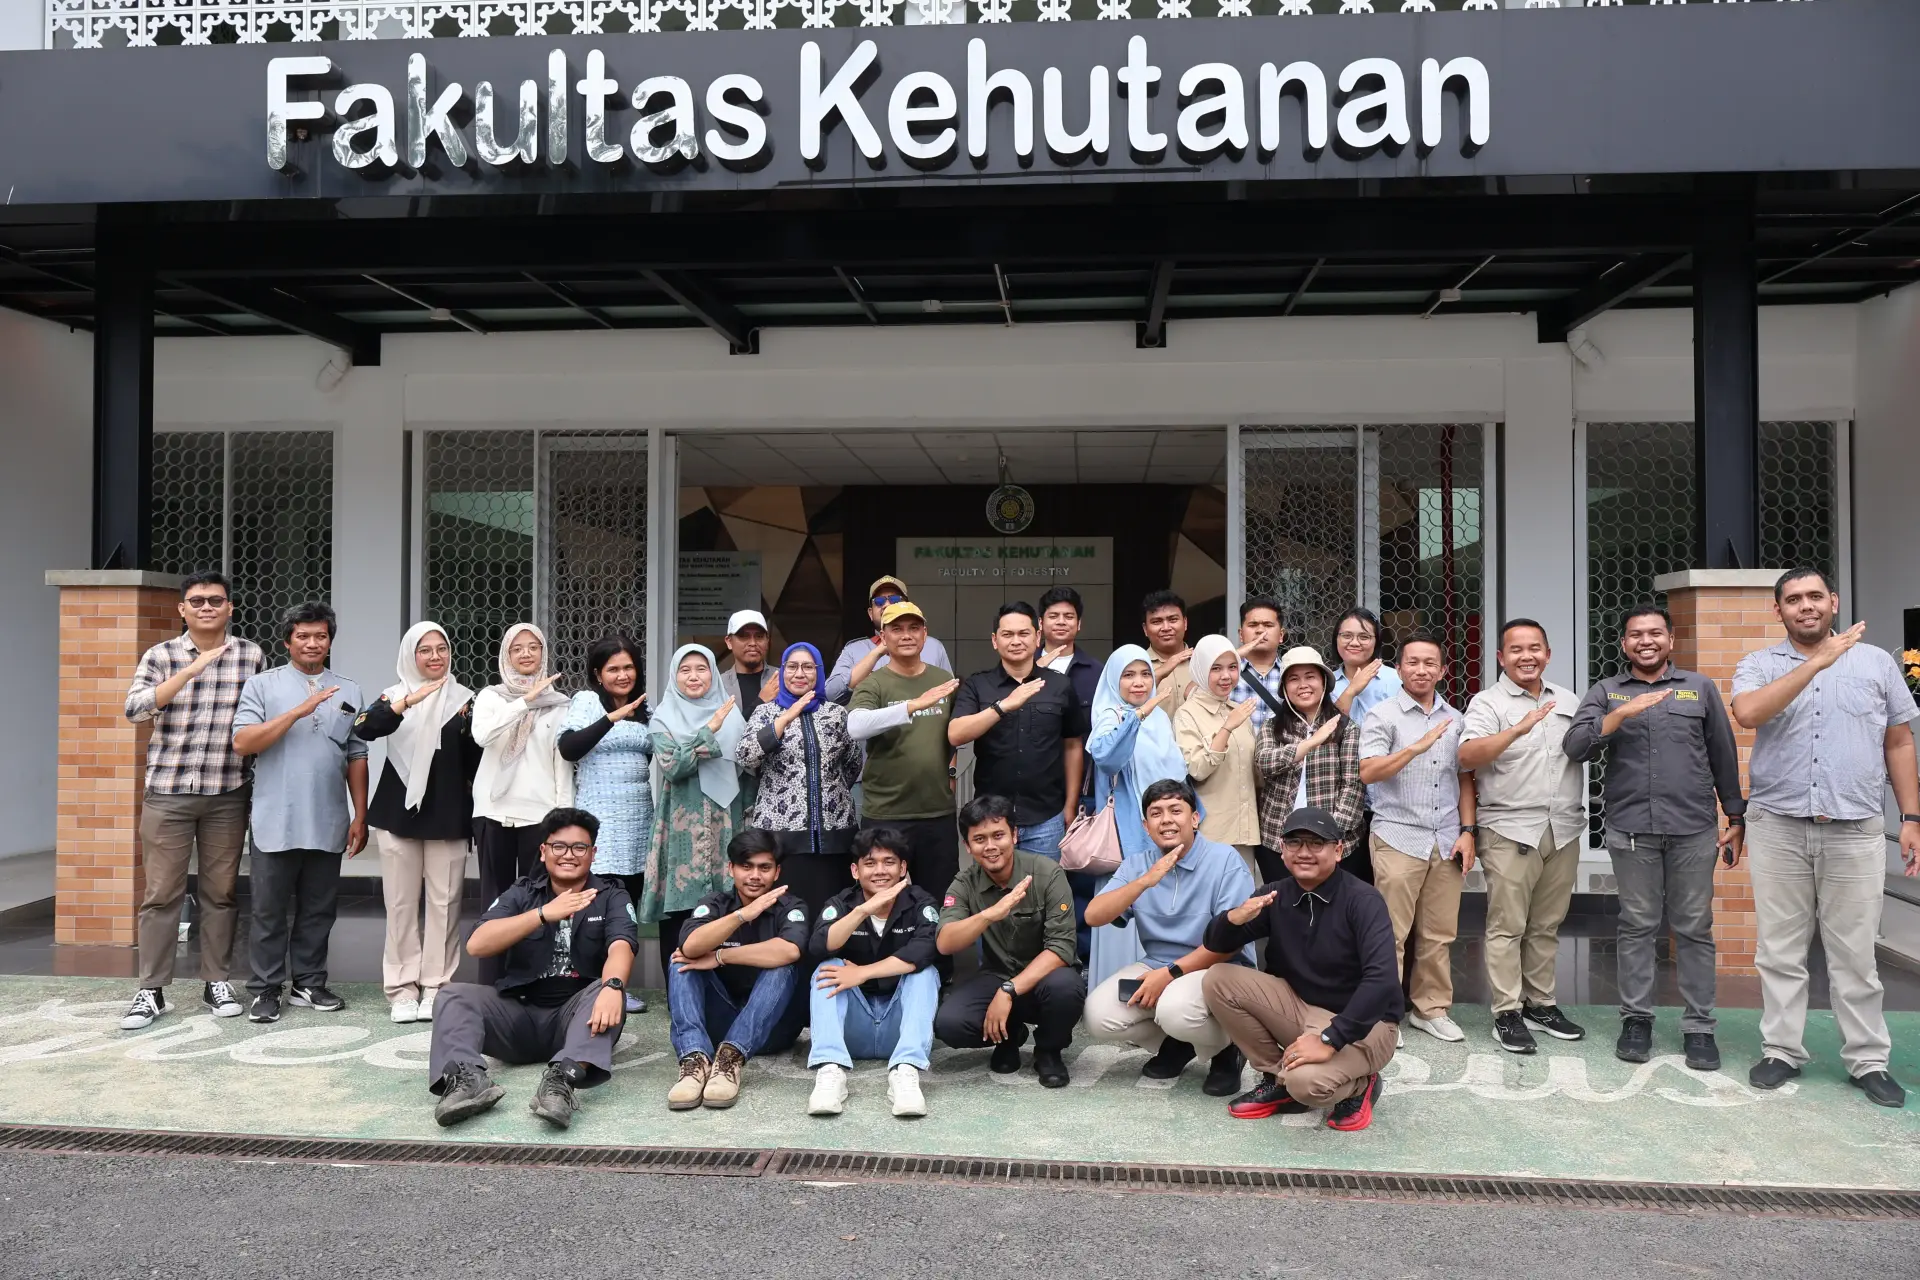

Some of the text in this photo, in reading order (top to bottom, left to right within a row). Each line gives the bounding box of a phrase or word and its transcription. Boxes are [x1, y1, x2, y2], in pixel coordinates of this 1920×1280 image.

[266, 34, 1490, 171] Fakultas Kehutanan
[914, 545, 1096, 559] FAKULTAS KEHUTANAN
[938, 567, 1070, 577] FACULTY OF FORESTRY
